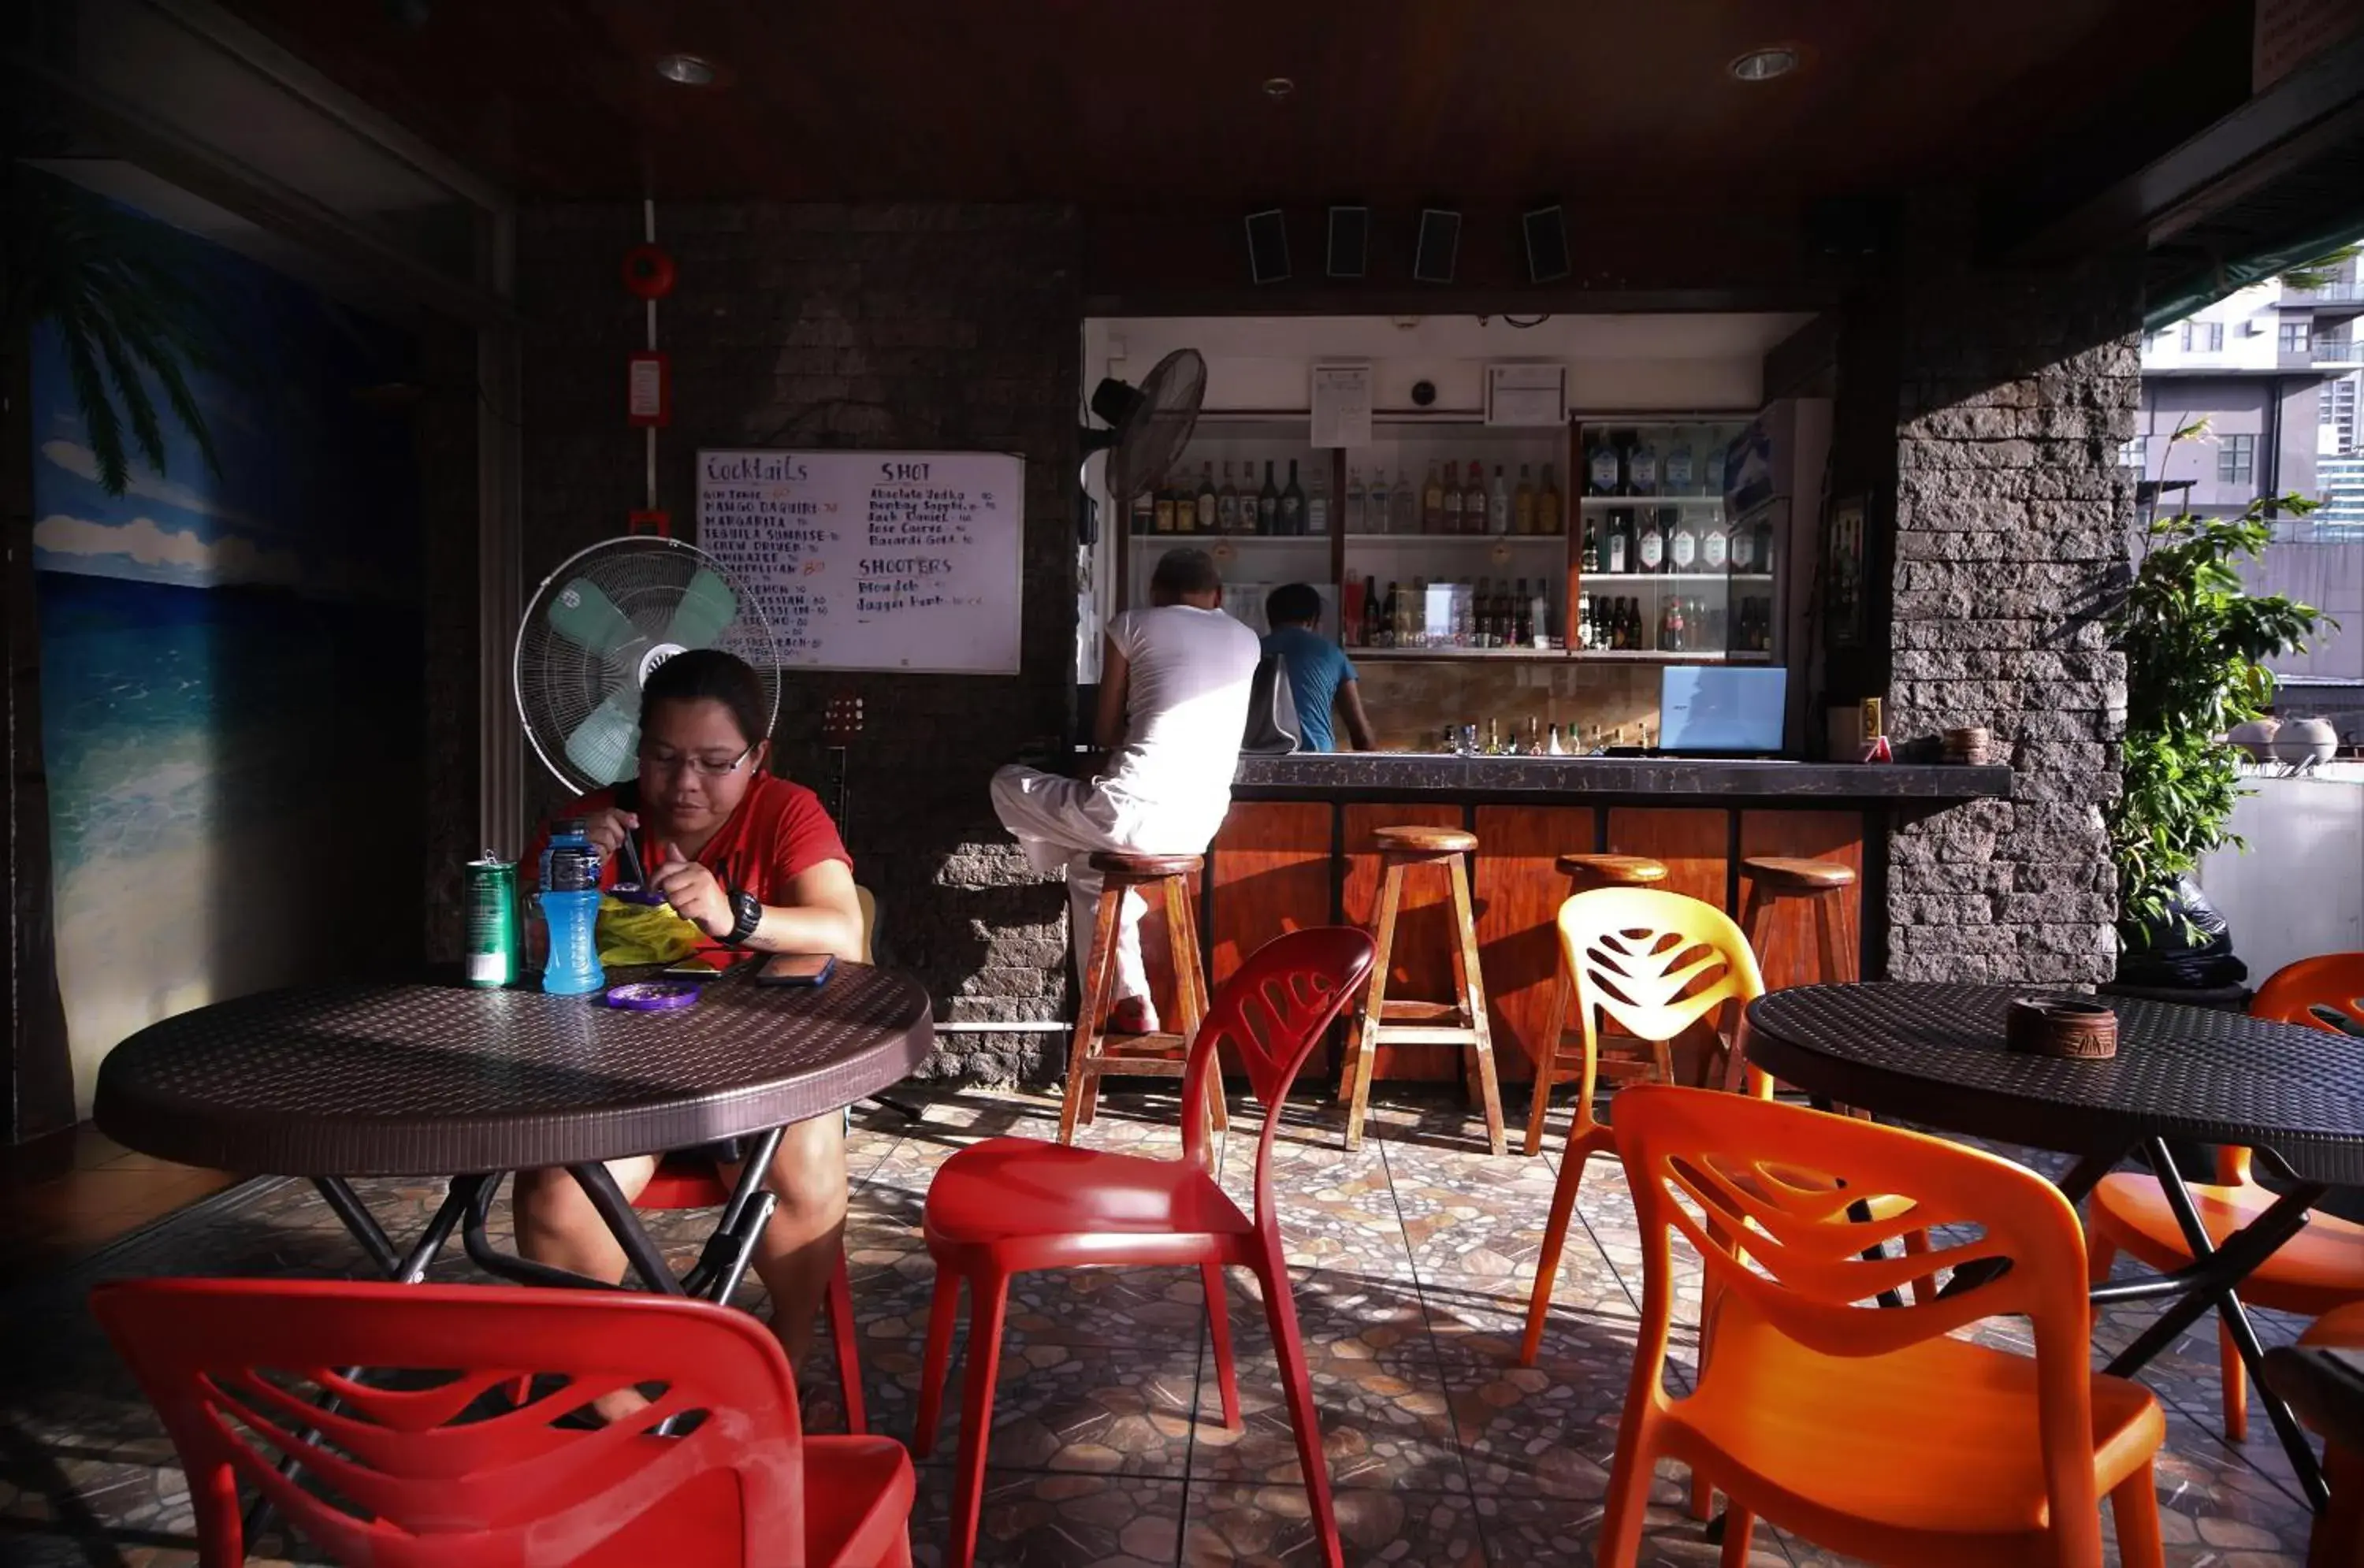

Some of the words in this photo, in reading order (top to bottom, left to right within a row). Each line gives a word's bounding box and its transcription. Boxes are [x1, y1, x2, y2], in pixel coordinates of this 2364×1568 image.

[707, 455, 808, 481] Cocktails
[881, 463, 931, 481] SHOT
[705, 502, 755, 513] MANGO
[705, 516, 786, 529] MARGARITA
[704, 529, 761, 540] TEQUILA
[767, 529, 825, 541] SUNRISE
[858, 558, 953, 576] SHOOTERS
